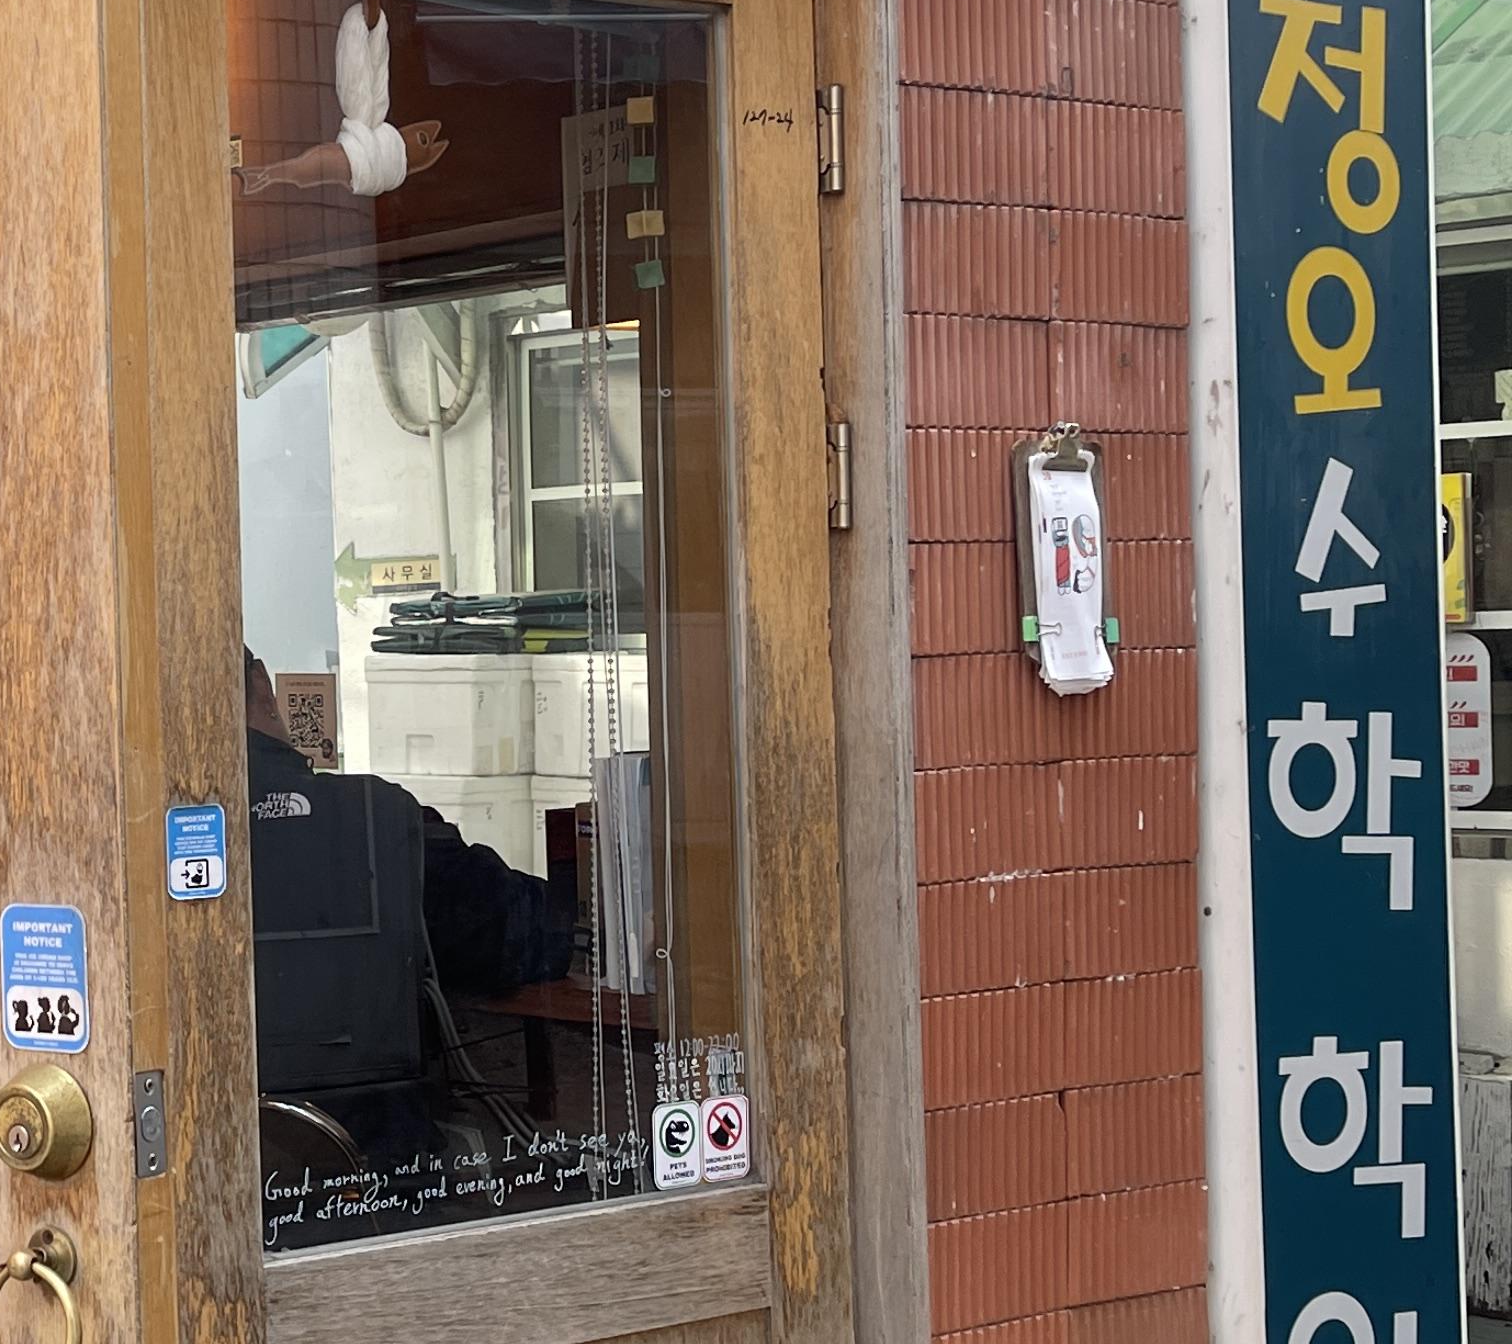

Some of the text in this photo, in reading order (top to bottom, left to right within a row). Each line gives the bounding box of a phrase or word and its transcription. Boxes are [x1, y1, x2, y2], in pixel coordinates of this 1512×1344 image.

[382, 562, 433, 582] 사무실
[267, 791, 290, 802] THE
[257, 807, 288, 821] FACE
[12, 920, 73, 935] IMPORTANT
[23, 935, 63, 949] NOTICE
[265, 1167, 313, 1200] Good
[323, 1168, 388, 1203] morning,
[395, 1155, 420, 1176] and
[430, 1154, 443, 1172] in
[453, 1150, 492, 1170] case
[502, 1134, 517, 1162] I
[528, 1129, 569, 1157] don't
[580, 1133, 610, 1149] see
[669, 1161, 687, 1170] PETS
[663, 1170, 696, 1181] ALLOWED
[264, 1201, 304, 1246] good
[316, 1194, 408, 1221] afternoon,
[412, 1175, 448, 1215] good
[515, 1162, 546, 1186] and
[554, 1153, 589, 1192] good
